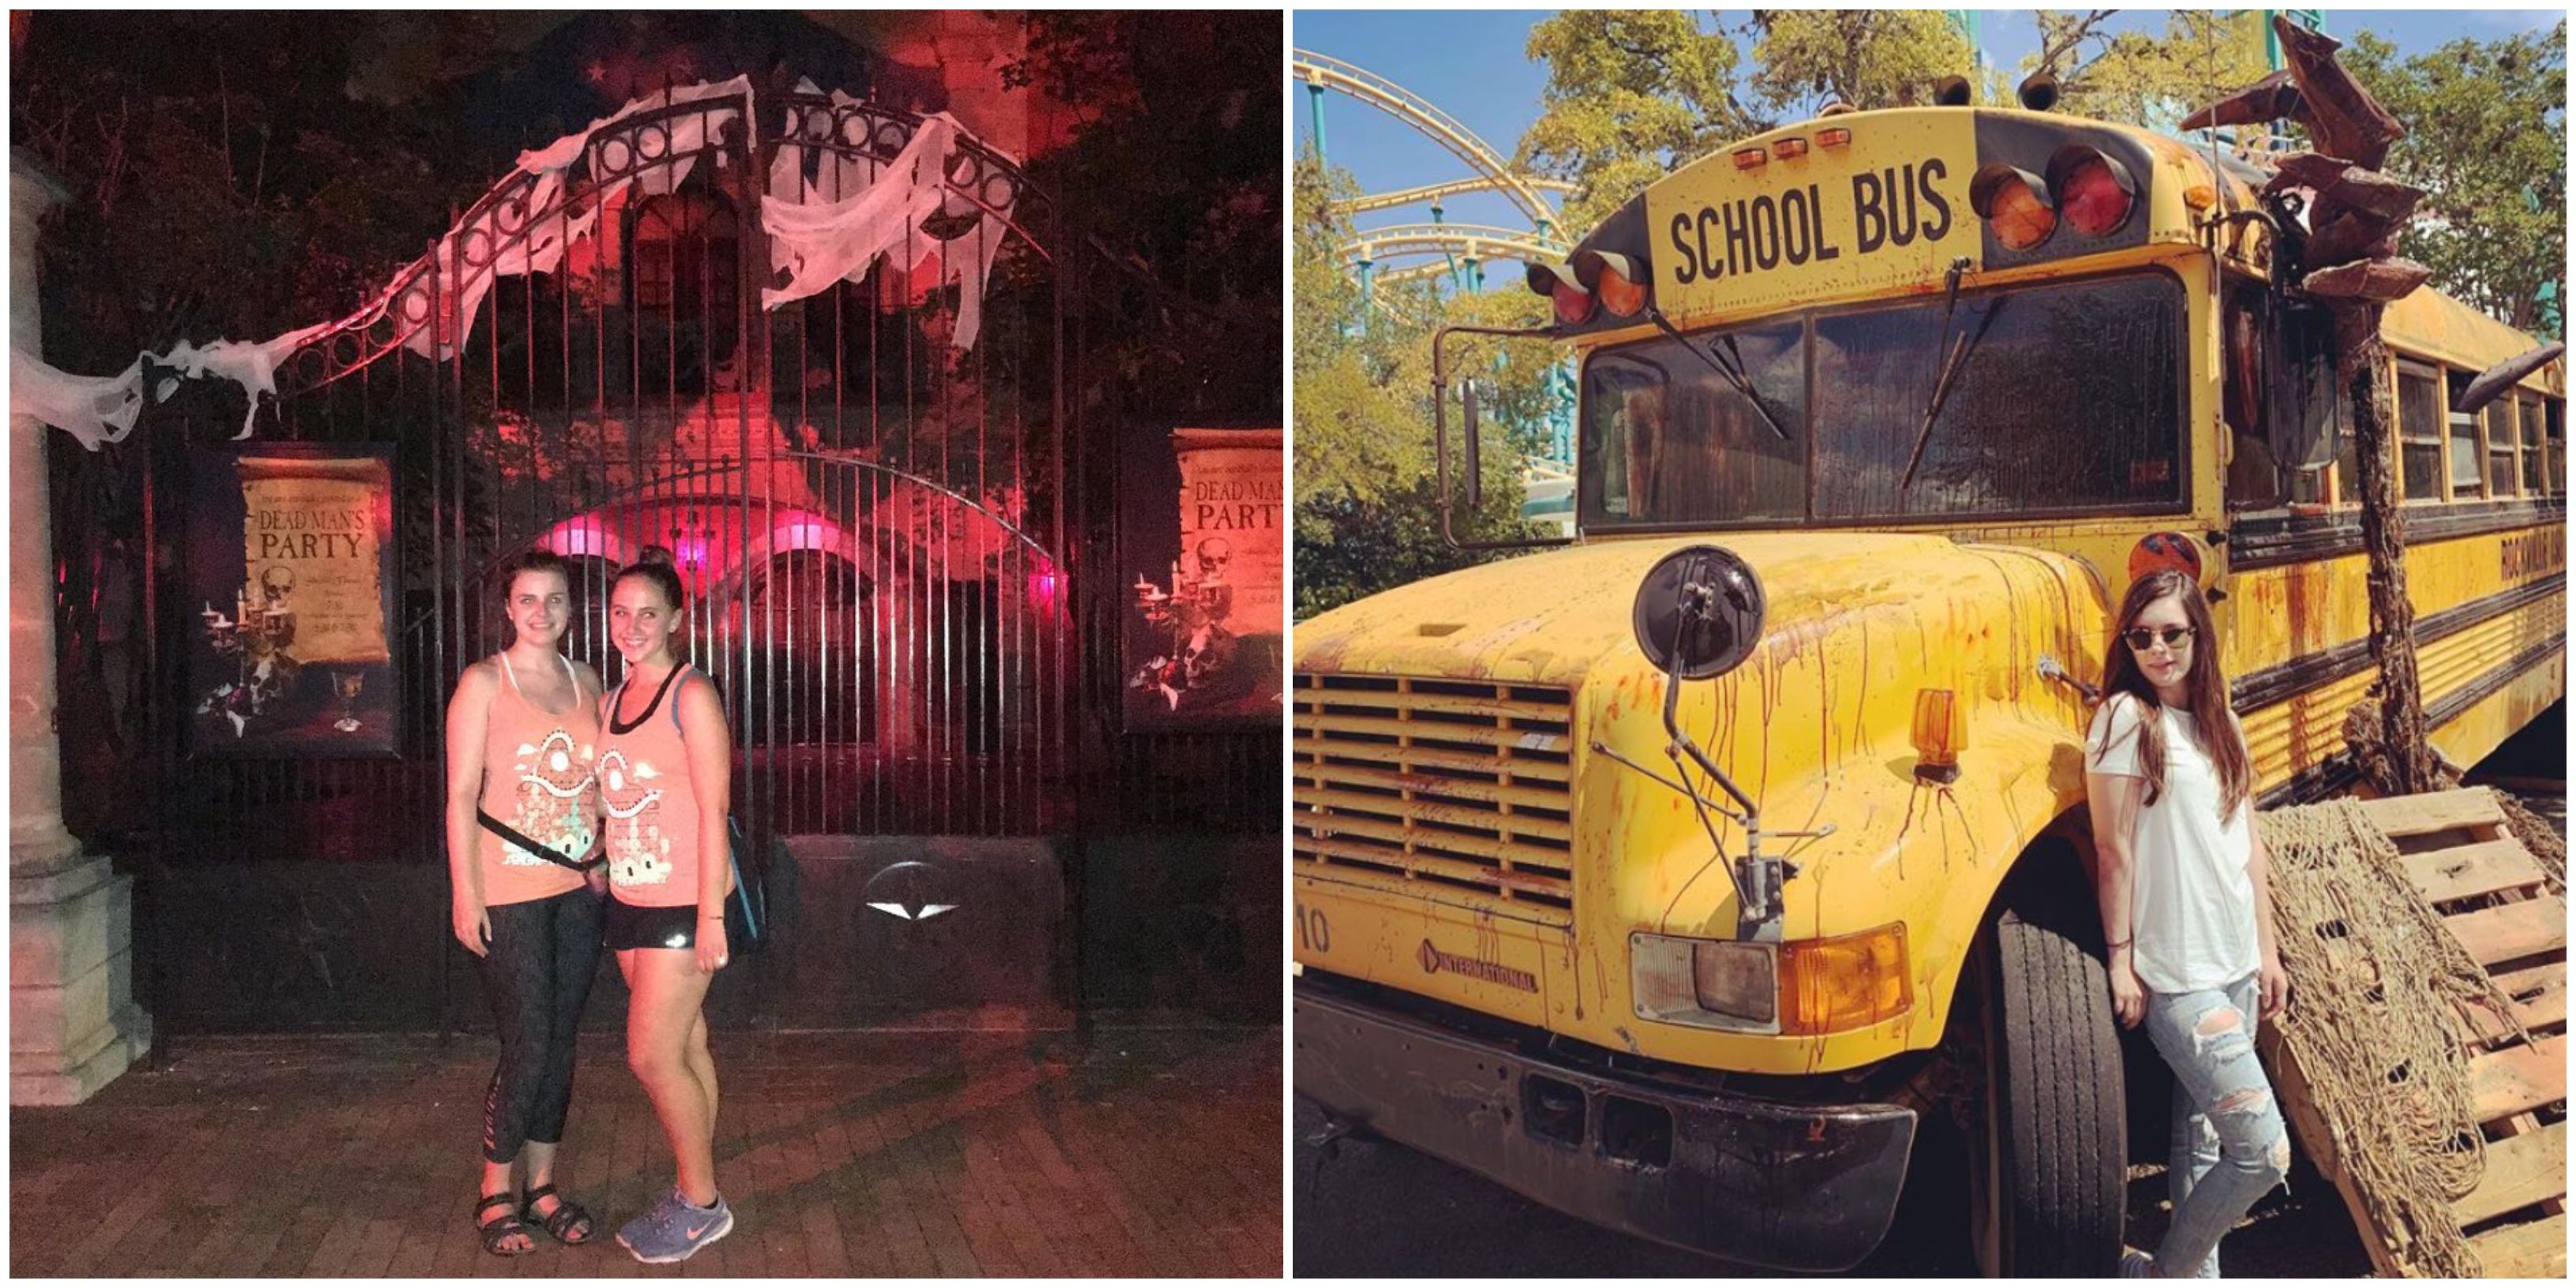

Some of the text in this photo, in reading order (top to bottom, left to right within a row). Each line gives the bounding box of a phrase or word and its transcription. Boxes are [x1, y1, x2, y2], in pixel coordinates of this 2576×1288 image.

[1671, 158, 1952, 285] SCHOOL BUS
[1196, 481, 1244, 501] DEAD
[260, 510, 365, 530] DEAD MAN'S
[1196, 504, 1283, 530] PART
[260, 533, 364, 559] PARTY
[1296, 904, 1330, 953] 10
[1438, 952, 1538, 993] INTERNATIONAL
